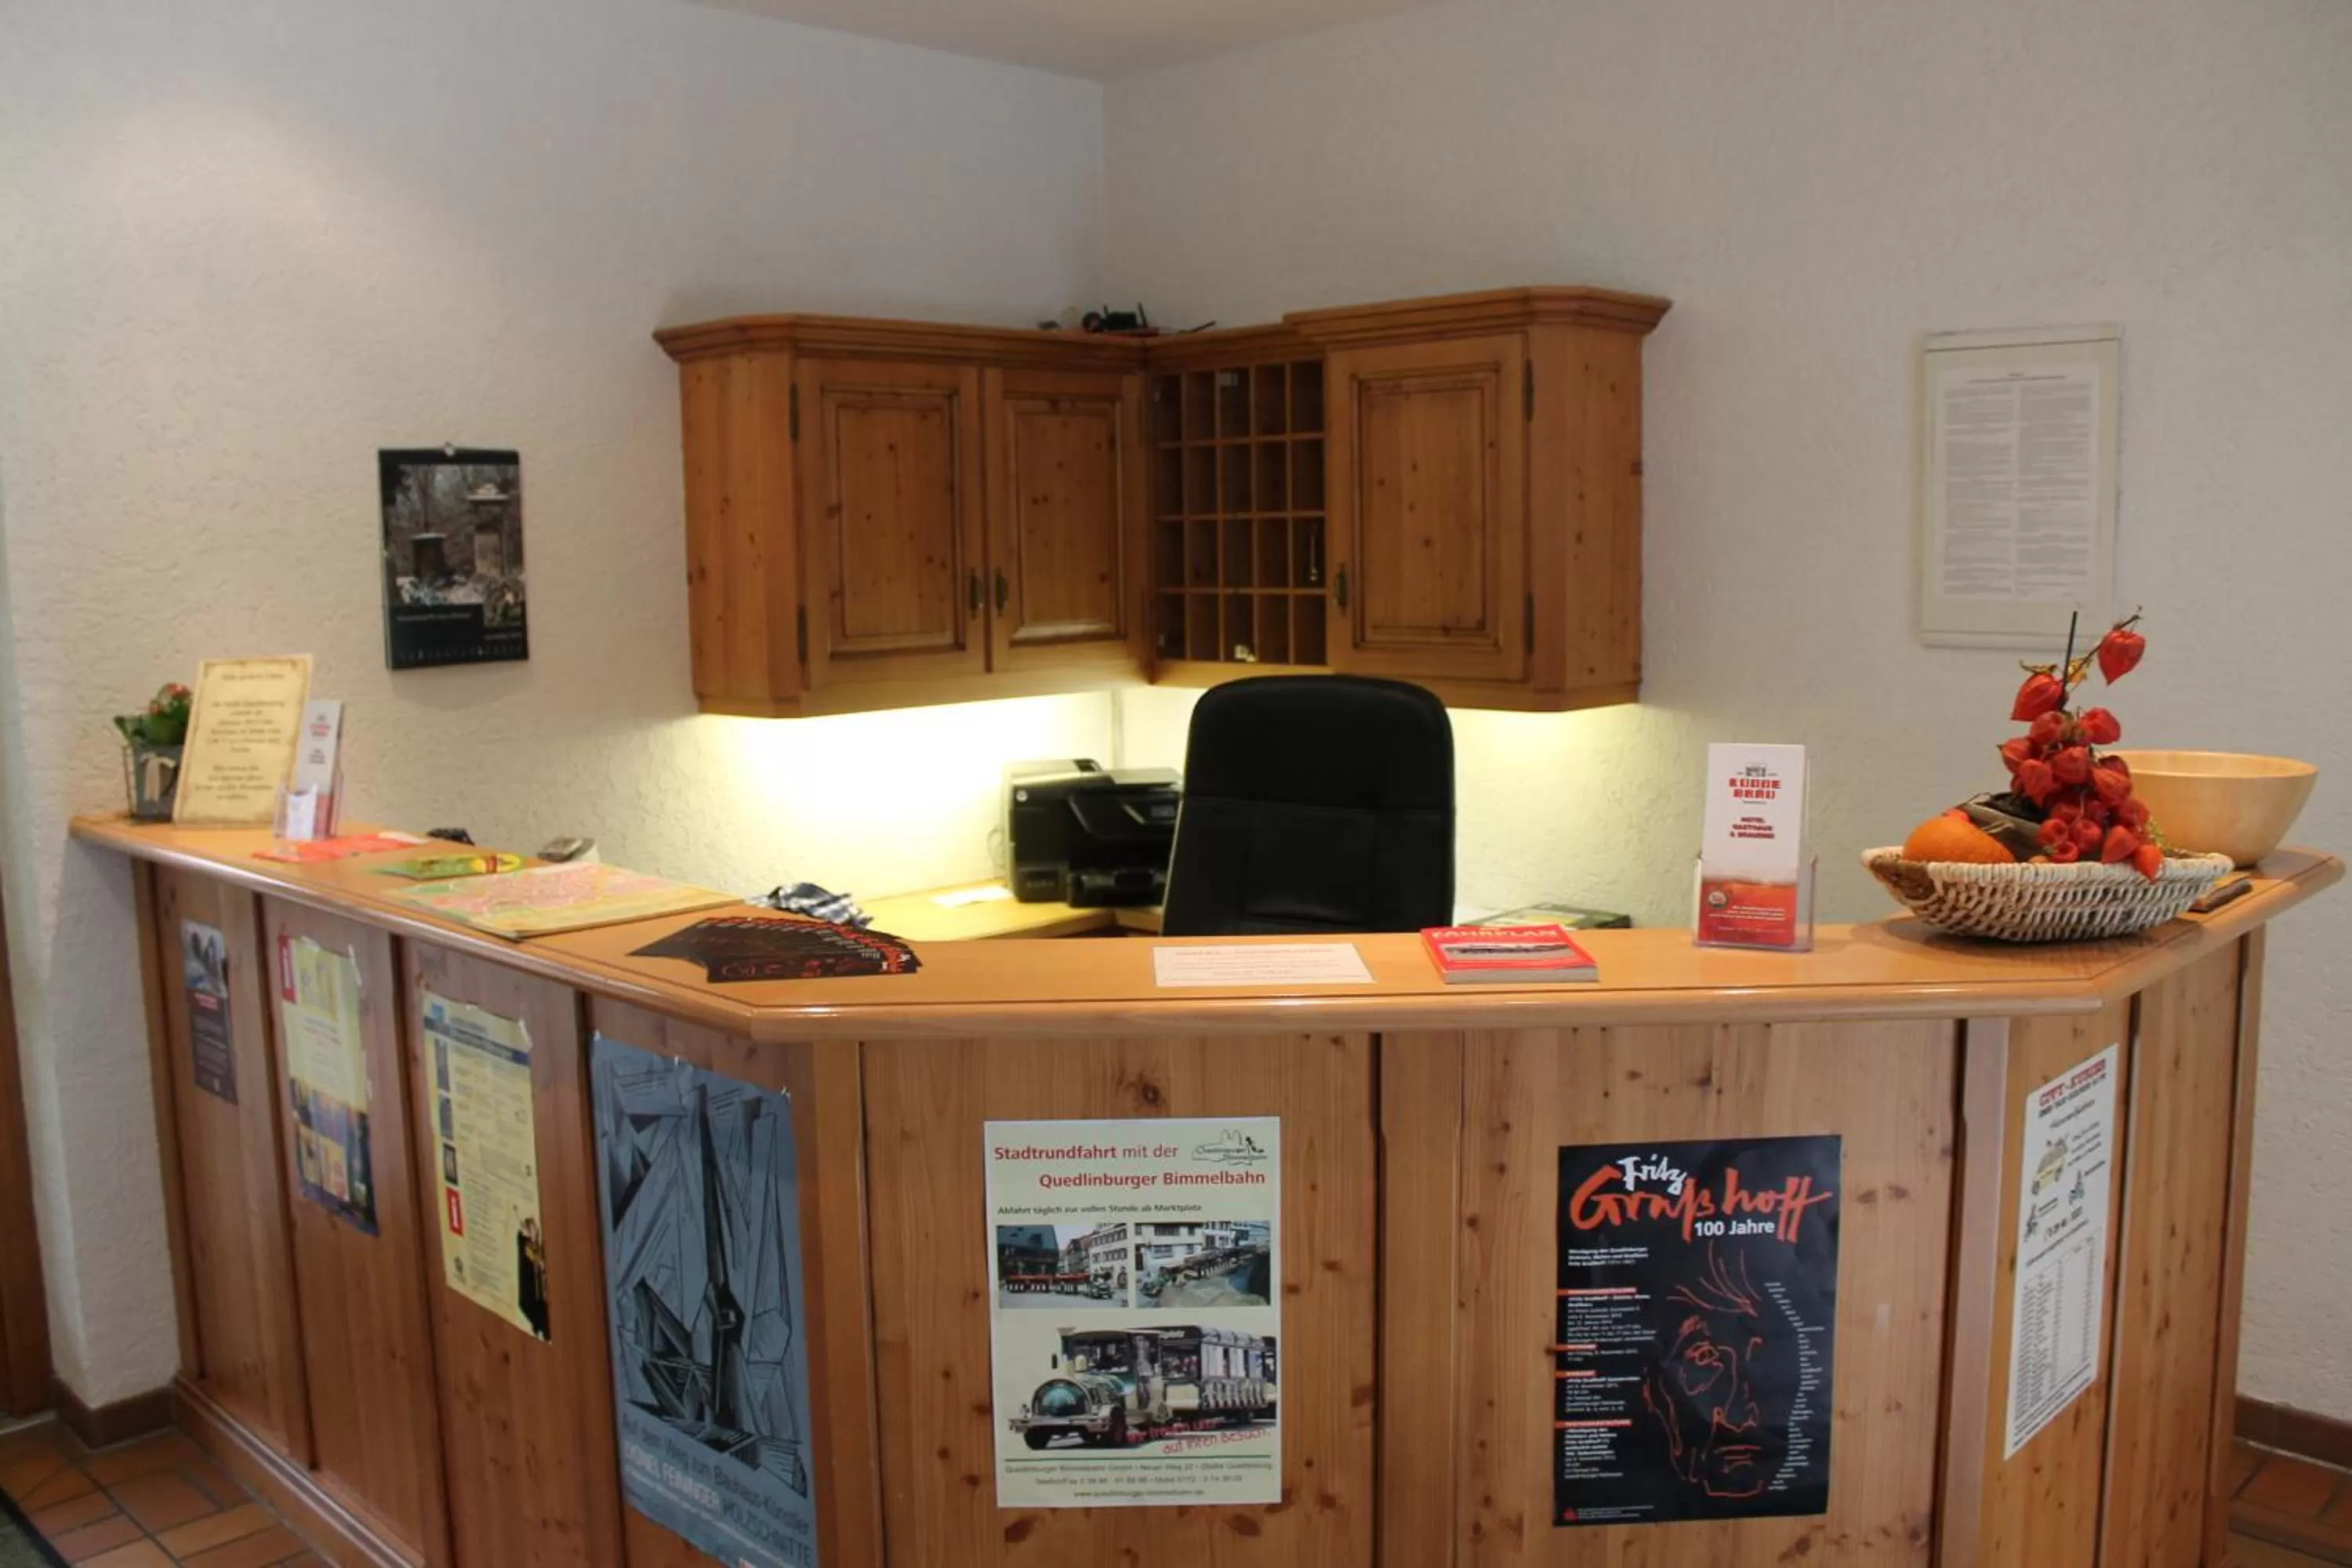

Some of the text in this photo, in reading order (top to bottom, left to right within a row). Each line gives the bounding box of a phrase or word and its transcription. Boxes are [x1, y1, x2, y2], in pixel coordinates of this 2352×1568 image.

[993, 1145, 1117, 1160] Stadtrundfahrt
[1122, 1146, 1148, 1159] mit
[1152, 1144, 1179, 1159] der
[1039, 1170, 1266, 1189] Quedlinburger Bimmelbahn
[1617, 1153, 1688, 1196] Fritz
[1693, 1219, 1776, 1237] 100 Jahre
[1162, 1439, 1184, 1454] auf
